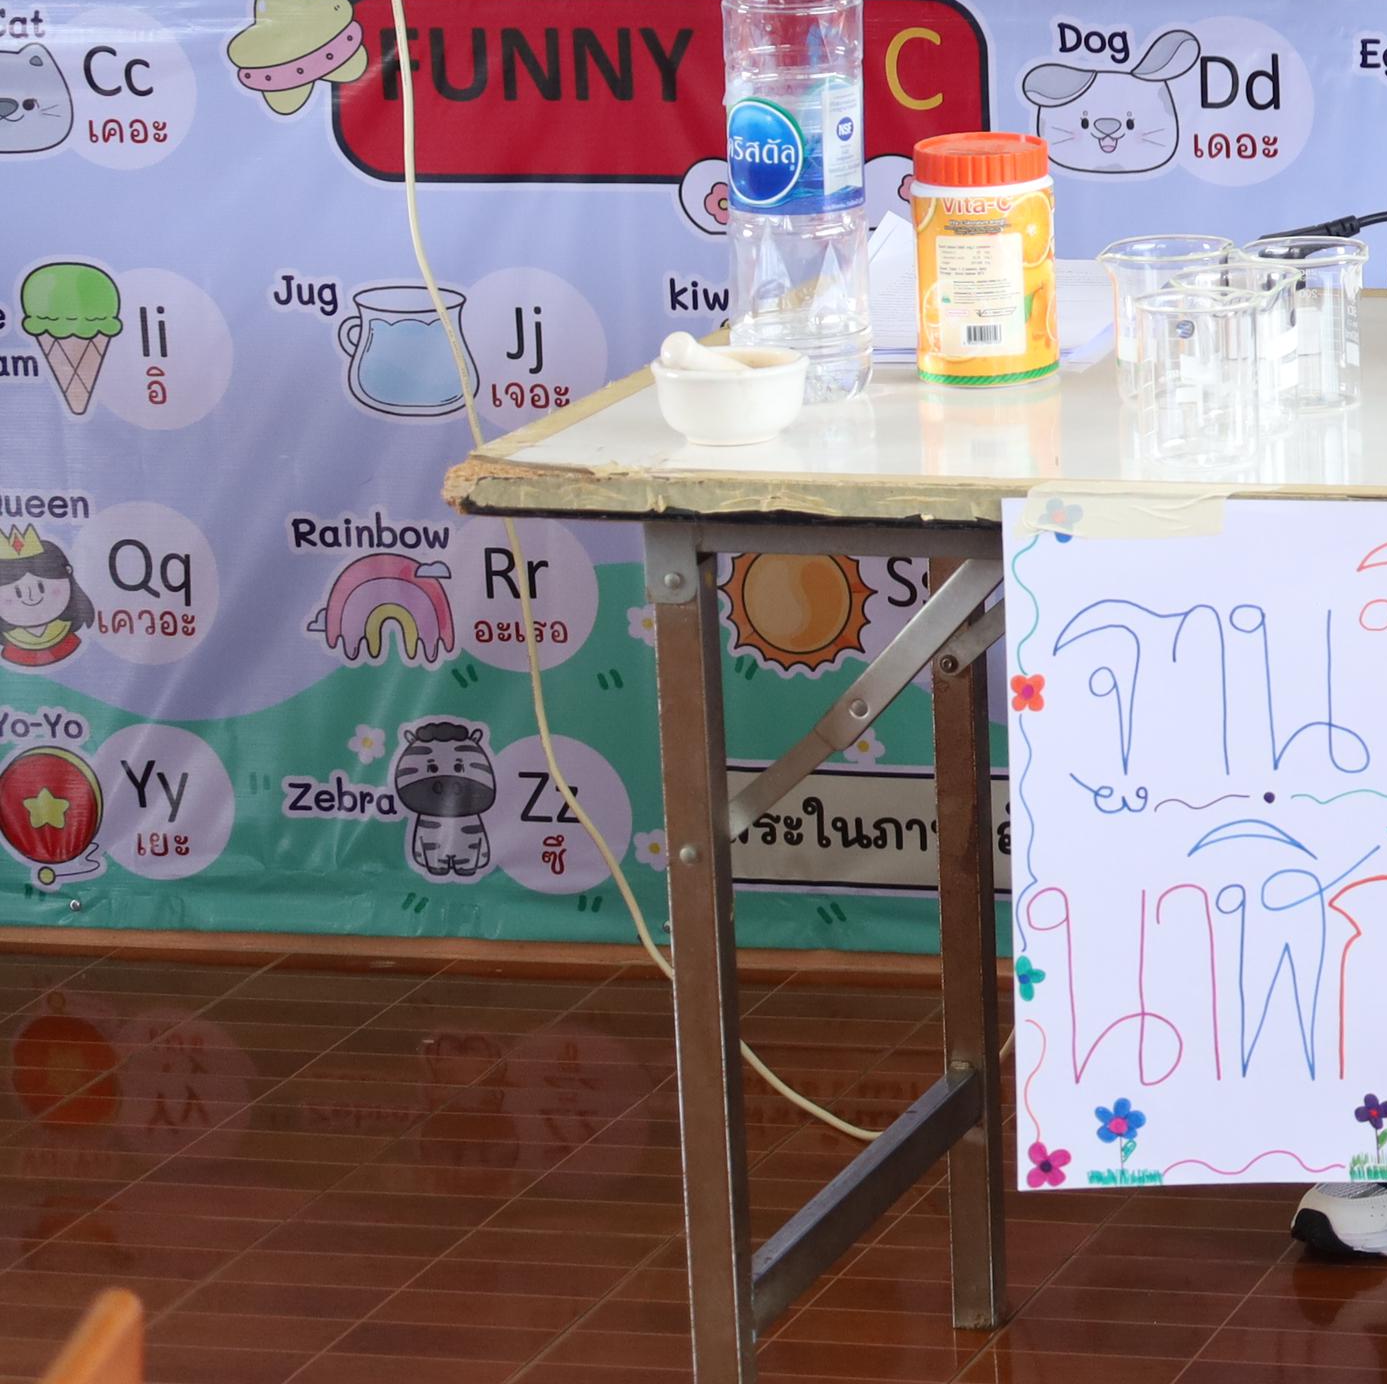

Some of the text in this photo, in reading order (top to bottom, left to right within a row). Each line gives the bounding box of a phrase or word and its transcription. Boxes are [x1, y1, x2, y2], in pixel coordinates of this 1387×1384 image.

[0, 8, 45, 38] at
[1057, 22, 1130, 64] Dog
[83, 45, 155, 97] Cc
[379, 26, 694, 103] FUNNY
[1199, 53, 1281, 110] Dd
[88, 117, 168, 144] เคอะ
[1193, 132, 1279, 159] เดอะ
[942, 197, 1012, 215] Vita-C
[273, 276, 338, 314] Jug
[669, 277, 729, 312] kiw
[506, 305, 546, 374] Jj
[146, 366, 167, 405] อิ
[490, 382, 571, 409] เจอะ
[292, 513, 450, 550] Rainbow
[108, 538, 193, 607] Qq
[484, 546, 548, 600] Rr
[97, 610, 196, 637] เควอะ
[121, 760, 190, 823] Yy
[288, 777, 398, 816] Zebra
[518, 771, 582, 823] Zz
